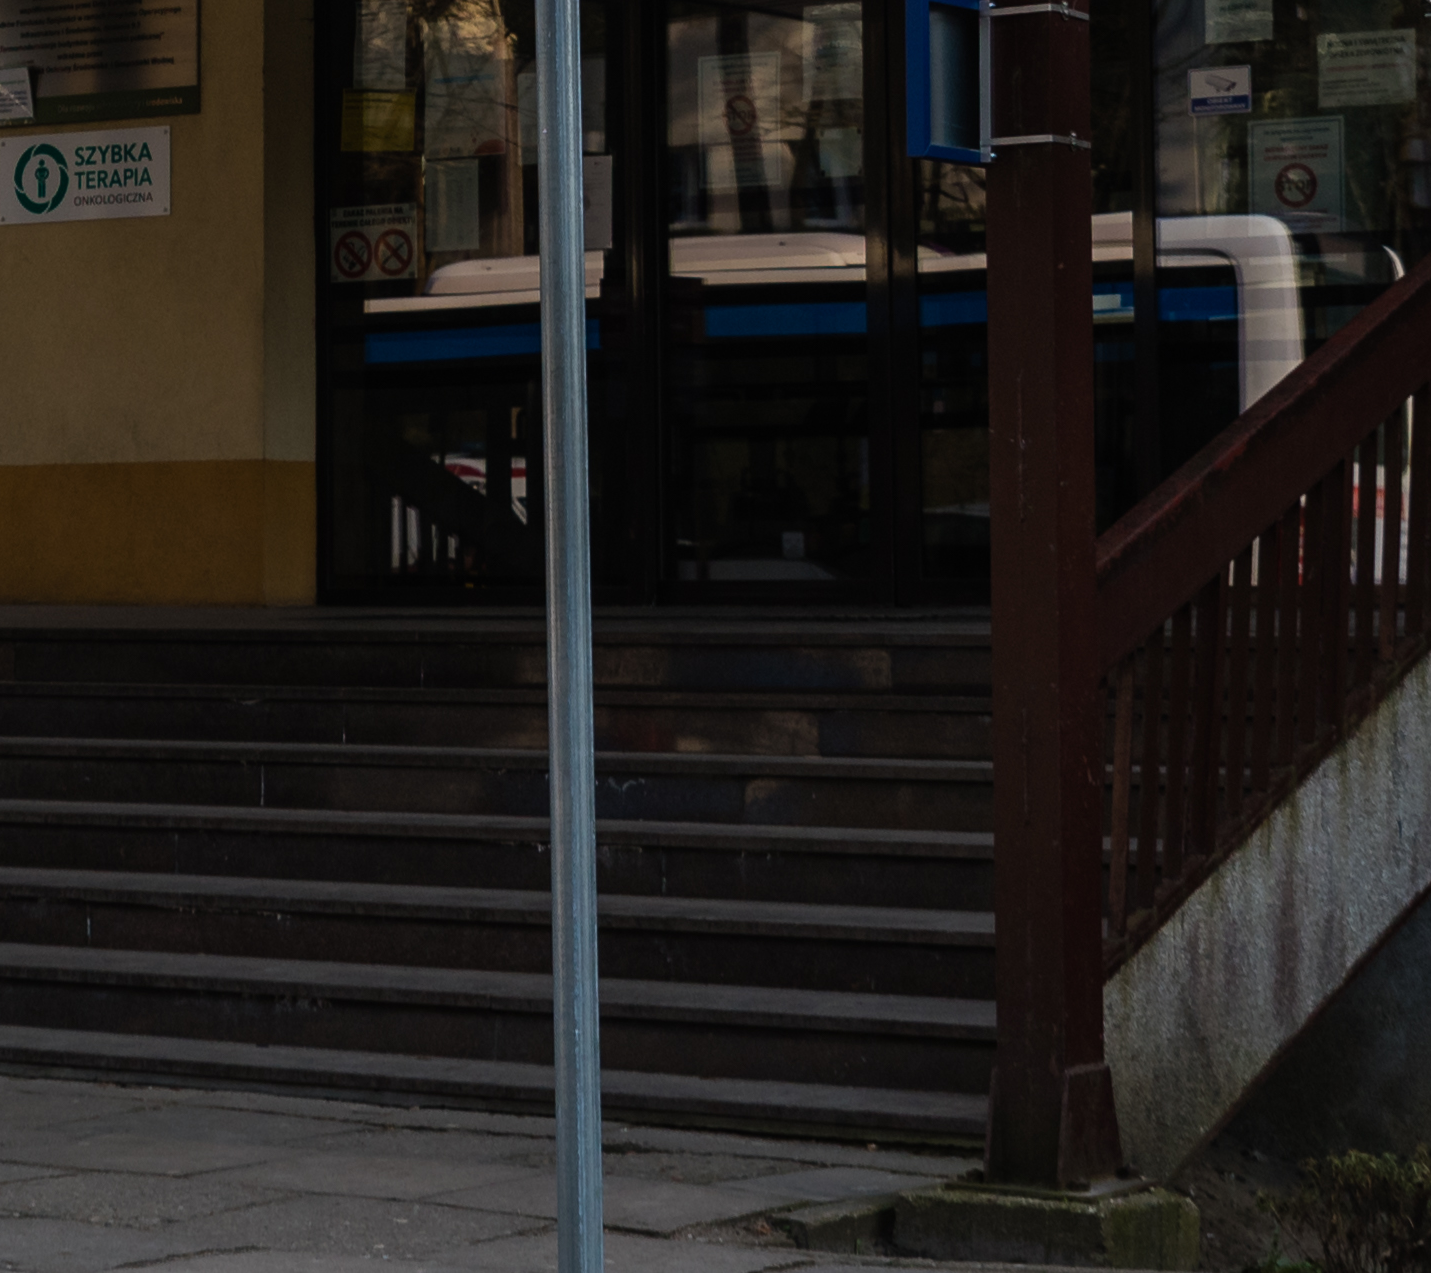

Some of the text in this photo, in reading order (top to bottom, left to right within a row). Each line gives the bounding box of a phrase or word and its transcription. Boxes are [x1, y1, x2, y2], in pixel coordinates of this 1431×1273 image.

[74, 142, 153, 166] SZYBKA
[74, 167, 153, 190] TERAPIA
[73, 192, 154, 207] ONKOLOGICZNA
